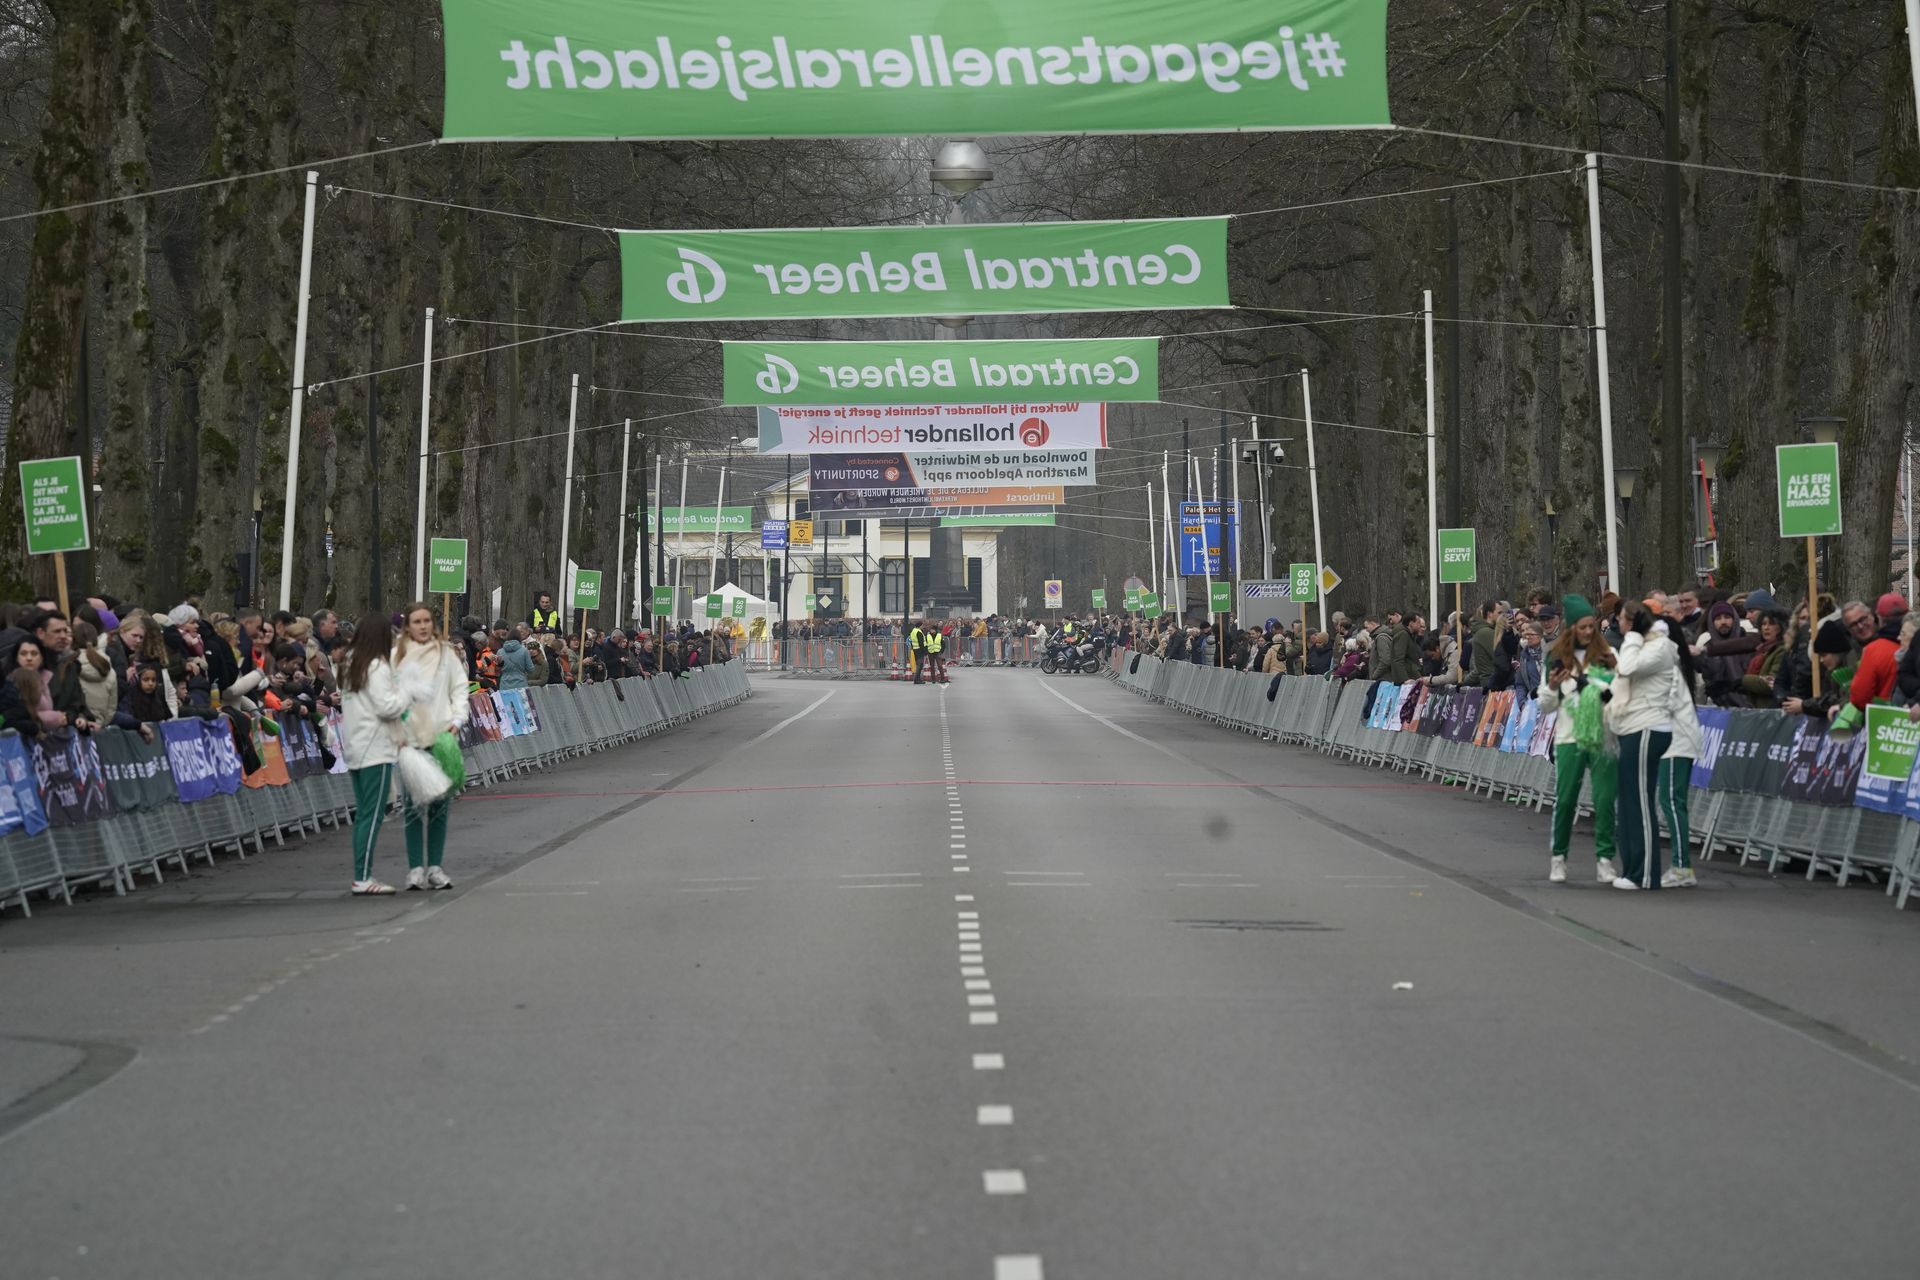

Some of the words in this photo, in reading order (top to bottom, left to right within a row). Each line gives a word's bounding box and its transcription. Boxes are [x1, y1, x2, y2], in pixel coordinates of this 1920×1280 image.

[33, 478, 48, 488] ALS
[50, 477, 59, 486] JE
[1788, 474, 1809, 485] ALS
[1811, 473, 1831, 484] EEN
[33, 487, 46, 497] DIT
[47, 485, 69, 495] KUNT
[1787, 484, 1831, 500] HAAS
[1786, 498, 1830, 508] ERVANDOOR
[33, 507, 45, 517] GA
[46, 506, 56, 515] JE
[56, 505, 66, 514] TE
[33, 514, 78, 526] LANGZAAM
[434, 558, 463, 566] INHALEN
[1444, 553, 1471, 562] SEXY!
[439, 565, 455, 573] MAG
[1297, 569, 1310, 578] GO
[580, 581, 595, 589] GAS
[1296, 578, 1309, 587] GO
[577, 588, 597, 597] EROP!
[1295, 587, 1309, 595] GO
